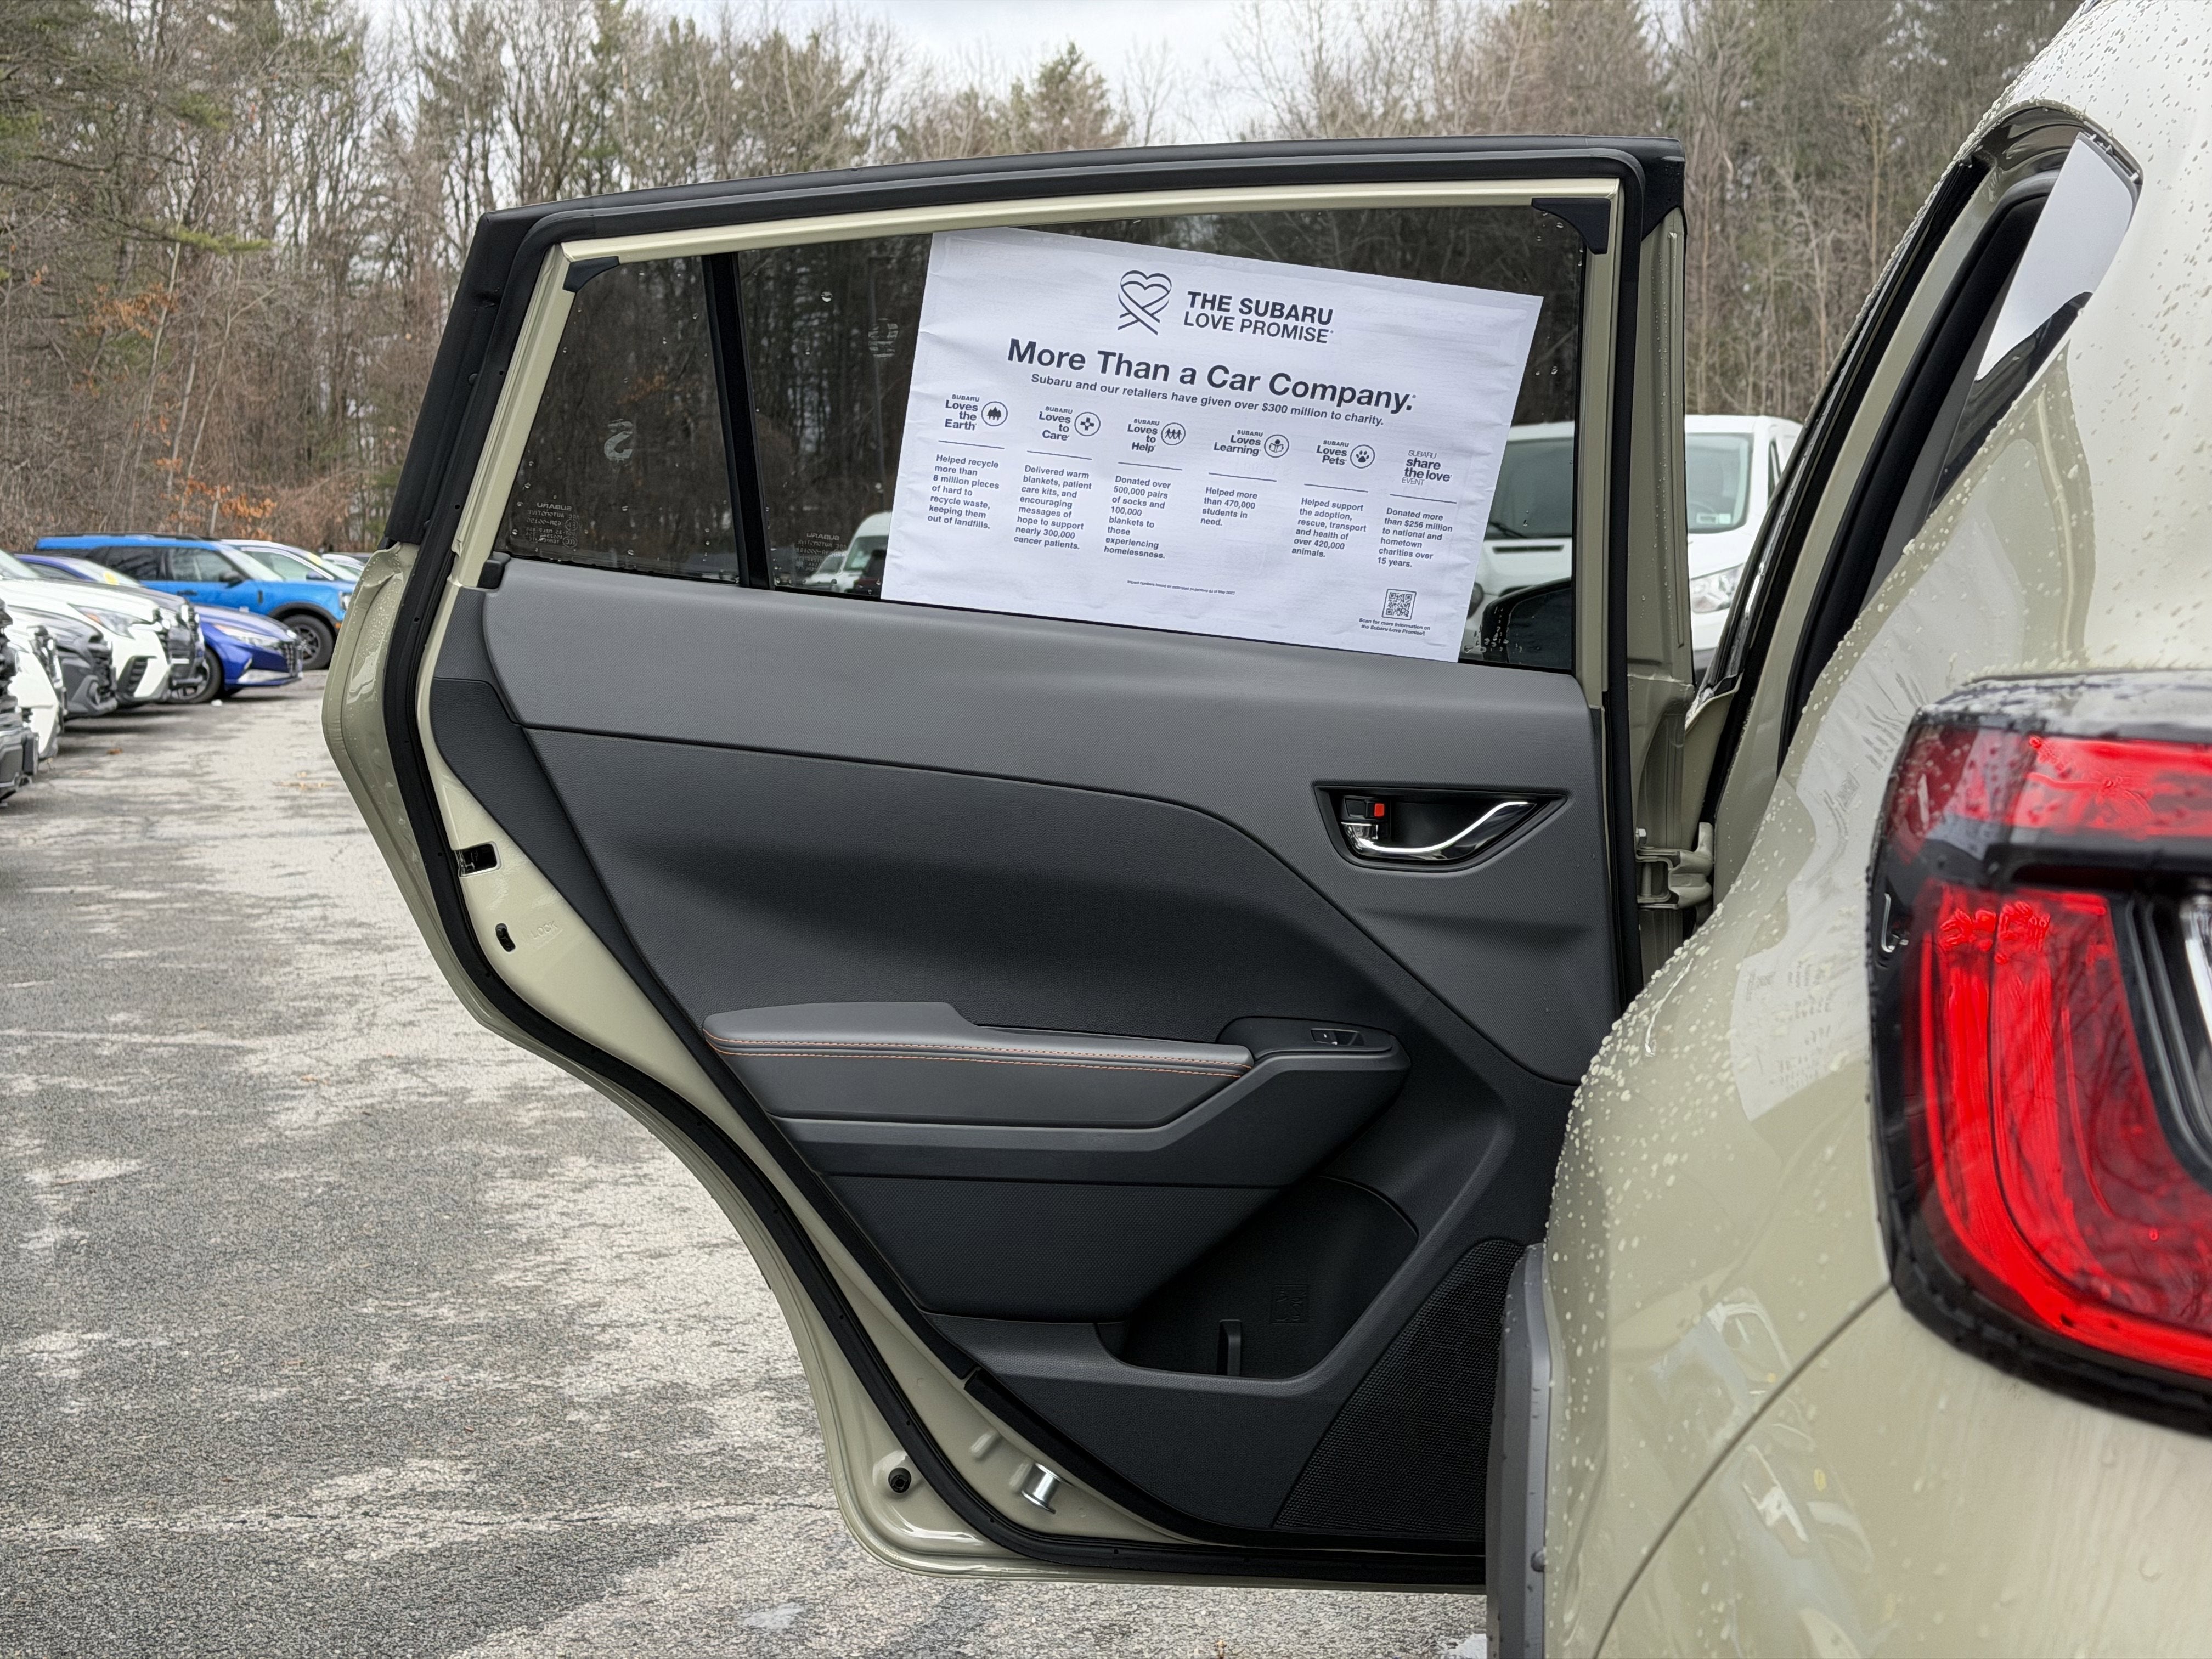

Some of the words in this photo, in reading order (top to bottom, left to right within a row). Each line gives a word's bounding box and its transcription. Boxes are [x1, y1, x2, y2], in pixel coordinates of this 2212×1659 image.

[1187, 290, 1233, 313] THE
[1238, 297, 1334, 326] SUBARU
[1183, 311, 1235, 332] LOVE
[1007, 338, 1086, 371] More
[1097, 349, 1170, 382] Than
[1179, 367, 1197, 386] a
[1206, 364, 1261, 392] Car
[951, 394, 980, 402] SUBARU
[1031, 373, 1073, 388] Subaru
[1075, 381, 1098, 391] and
[1100, 385, 1120, 394] our
[1122, 387, 1168, 400] retailers
[1171, 391, 1198, 403] have
[1200, 396, 1232, 408] given
[1234, 401, 1260, 410] over
[1261, 402, 1289, 414] $300
[1290, 406, 1328, 419] million
[1330, 410, 1342, 420] to
[1344, 412, 1384, 427] charity.
[945, 399, 979, 412] Loves
[1045, 405, 1073, 415] SUBARU
[958, 410, 977, 421] the
[1039, 411, 1071, 424] Loves
[1133, 418, 1160, 426] SUBARU
[1058, 423, 1070, 433] to
[1127, 423, 1158, 435] Loves
[1237, 429, 1263, 437] SUBARU
[1146, 435, 1156, 443] to
[1229, 434, 1261, 446] Loves
[1323, 439, 1350, 448] SUBARU
[1316, 444, 1348, 457] Loves
[1408, 449, 1437, 459] SUBARU
[936, 454, 967, 465] Helped
[968, 459, 999, 469] recycle
[1406, 457, 1441, 470] share
[934, 465, 957, 473] more
[958, 467, 978, 476] than
[1024, 464, 1065, 477] Delivered
[1066, 471, 1090, 479] warm
[1404, 467, 1424, 479] the
[932, 473, 939, 482] 8
[940, 475, 970, 486] million
[971, 479, 1000, 489] pieces
[1022, 474, 1061, 488] blankets,
[1062, 480, 1092, 490] patient
[1115, 475, 1151, 487] Donated
[1152, 481, 1171, 489] over
[1401, 477, 1425, 486] EVENT
[942, 485, 963, 495] hard
[964, 488, 973, 496] to
[1021, 486, 1040, 494] care
[1041, 487, 1059, 498] kits,
[1061, 490, 1077, 499] and
[1113, 485, 1146, 496] 500,000
[1147, 490, 1169, 500] pairs
[1205, 486, 1235, 498] Helped
[1236, 492, 1258, 500] more
[930, 495, 961, 505] recycle
[963, 500, 990, 510] waste,
[1019, 496, 1073, 510] encouraging
[1111, 495, 1121, 504] of
[1122, 498, 1147, 507] socks
[1149, 501, 1166, 509] and
[1204, 496, 1223, 506] than
[1223, 499, 1256, 510] 470,000
[1301, 497, 1330, 509] Helped
[1331, 502, 1364, 512] support
[929, 504, 963, 517] keeping
[965, 509, 986, 518] them
[1018, 506, 1061, 518] messages
[1110, 505, 1142, 517] 100,000
[1202, 507, 1238, 518] students
[1239, 510, 1248, 519] in
[1299, 507, 1313, 516] the
[1314, 510, 1352, 522] adoption,
[1386, 507, 1421, 519] Donated
[1421, 513, 1444, 522] more
[943, 516, 953, 524] of
[954, 517, 990, 529] landfills.
[1017, 515, 1039, 526] hope
[1040, 518, 1049, 526] to
[1051, 521, 1084, 531] support
[1109, 515, 1144, 527] blankets
[1146, 520, 1155, 528] to
[1200, 518, 1223, 527] need.
[1297, 519, 1327, 529] rescue,
[1329, 521, 1367, 533] transport
[1384, 517, 1403, 526] than
[1404, 519, 1424, 529] $256
[1425, 522, 1453, 532] million
[1015, 527, 1042, 537] nearly
[1043, 528, 1076, 539] 300,000
[1107, 526, 1131, 535] those
[1295, 528, 1312, 537] and
[1312, 529, 1339, 539] health
[1340, 532, 1350, 540] of
[1382, 527, 1391, 535] to
[1392, 529, 1426, 539] national
[1426, 533, 1443, 541] and
[1013, 536, 1043, 545] cancer
[1043, 539, 1080, 550] patients.
[1105, 537, 1159, 550] experiencing
[1293, 538, 1313, 546] over
[1313, 539, 1346, 550] 420,000
[1380, 537, 1423, 549] hometown
[1103, 545, 1165, 559] homelessness.
[1291, 547, 1326, 558] animals.
[1378, 546, 1414, 558] charities
[1414, 552, 1434, 560] over
[1377, 556, 1387, 565] 15
[1388, 559, 1413, 568] years.
